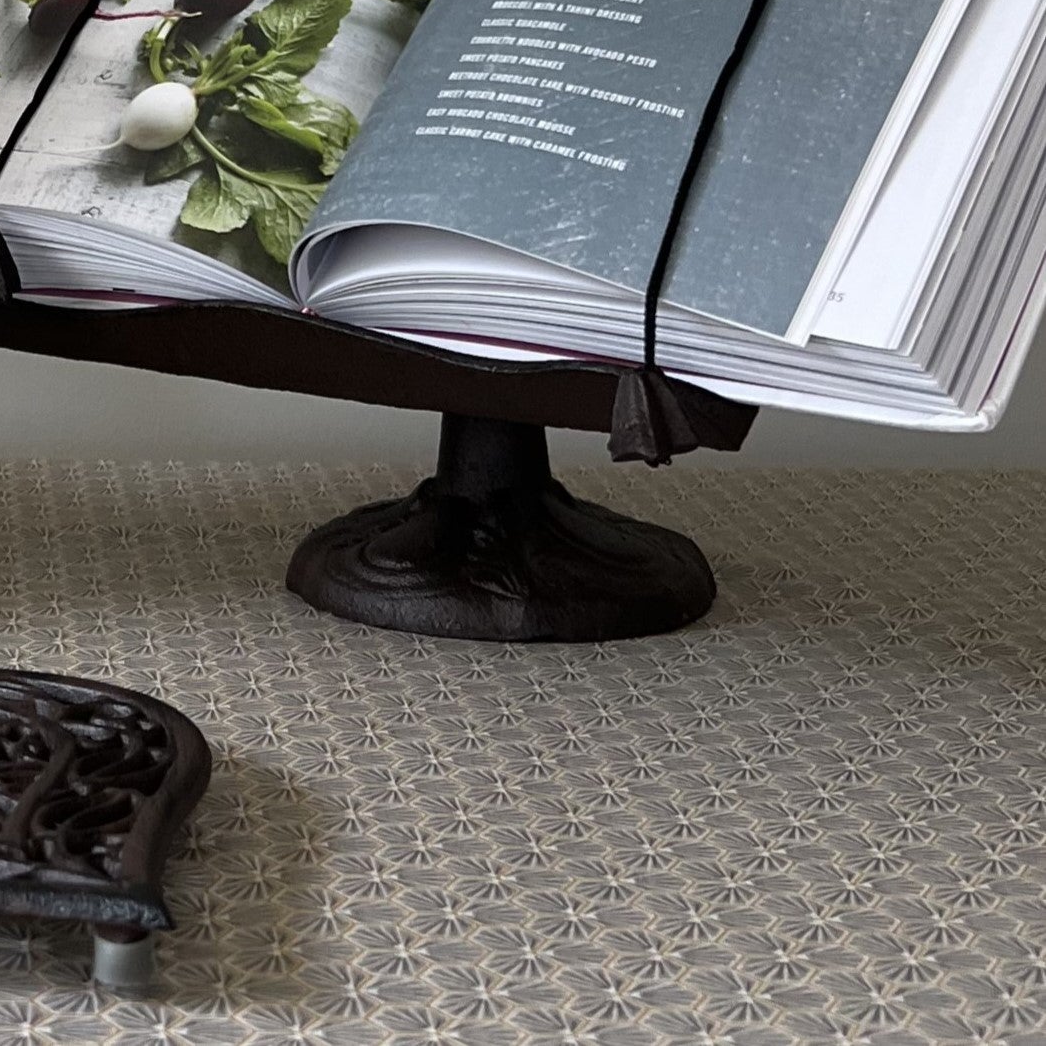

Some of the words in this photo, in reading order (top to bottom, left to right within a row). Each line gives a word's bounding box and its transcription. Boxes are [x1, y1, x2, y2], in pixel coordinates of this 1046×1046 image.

[515, 19, 567, 31] GUACAMOLE
[533, 2, 556, 11] WITH
[556, 4, 563, 12] A
[565, 4, 596, 16] TAHINI
[596, 9, 643, 24] DRESSING
[459, 54, 487, 63] SWEET
[486, 55, 518, 64] POTATO
[519, 57, 565, 71] PANCAKES
[470, 36, 516, 45] COURGETTE
[516, 38, 556, 49] NOODLES
[557, 42, 582, 53] WITH
[582, 46, 625, 61] AVOCADO
[626, 55, 657, 68] PESTO
[437, 89, 465, 98] SWEET
[464, 90, 497, 100] POTATO
[496, 92, 544, 108] BROWNIES
[489, 72, 539, 86] CHOCOLATE
[540, 78, 564, 91] CAKE
[565, 83, 590, 95] WITH
[590, 89, 636, 106] COCONUT
[636, 99, 685, 119] FROSTING
[426, 108, 447, 117] EASY
[446, 108, 485, 119] AVOCADO
[485, 111, 536, 127] CHOCOLATE
[536, 119, 577, 136] MOUSSE
[448, 126, 483, 138] CARROT
[483, 131, 507, 142] CAKE
[507, 135, 532, 147] WITH
[532, 140, 576, 158] CARAMEL
[577, 151, 627, 172] FROSTING
